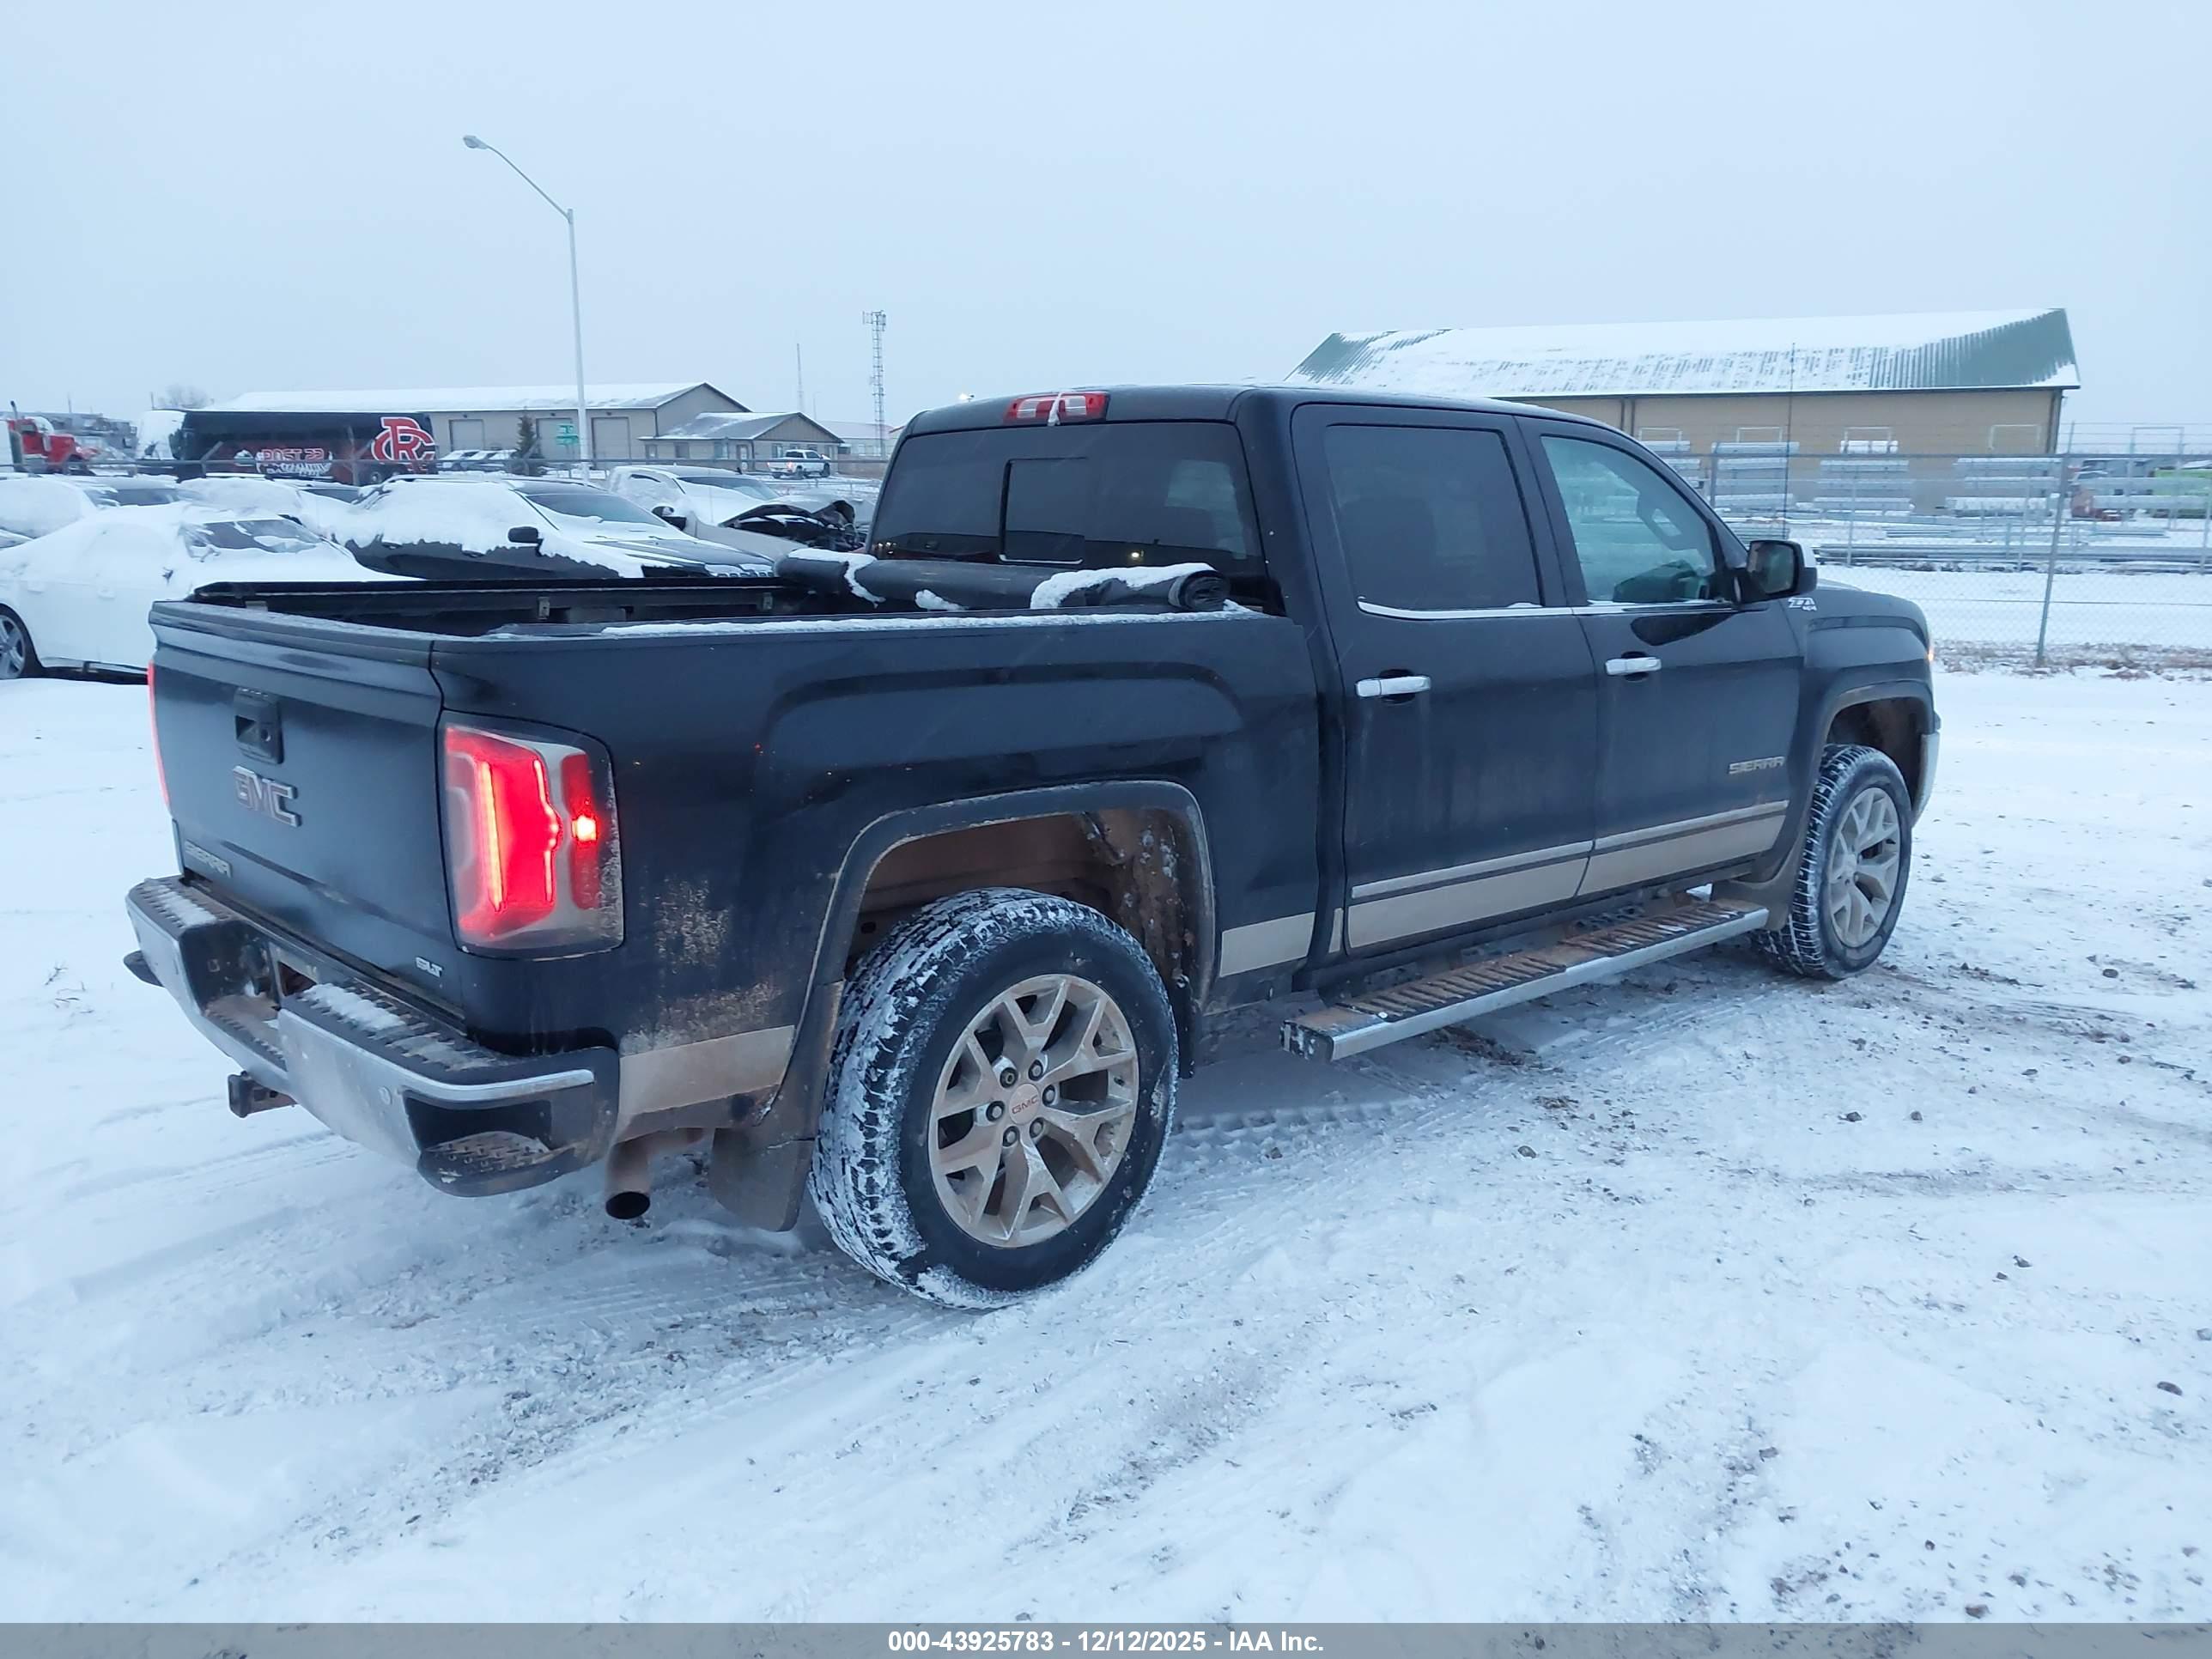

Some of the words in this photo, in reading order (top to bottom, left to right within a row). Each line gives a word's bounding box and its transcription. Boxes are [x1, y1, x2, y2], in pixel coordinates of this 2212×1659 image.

[1729, 756, 1785, 775] SIERRA
[232, 765, 297, 828] GMC
[416, 957, 443, 978] SLT
[1012, 1094, 1038, 1115] GMC
